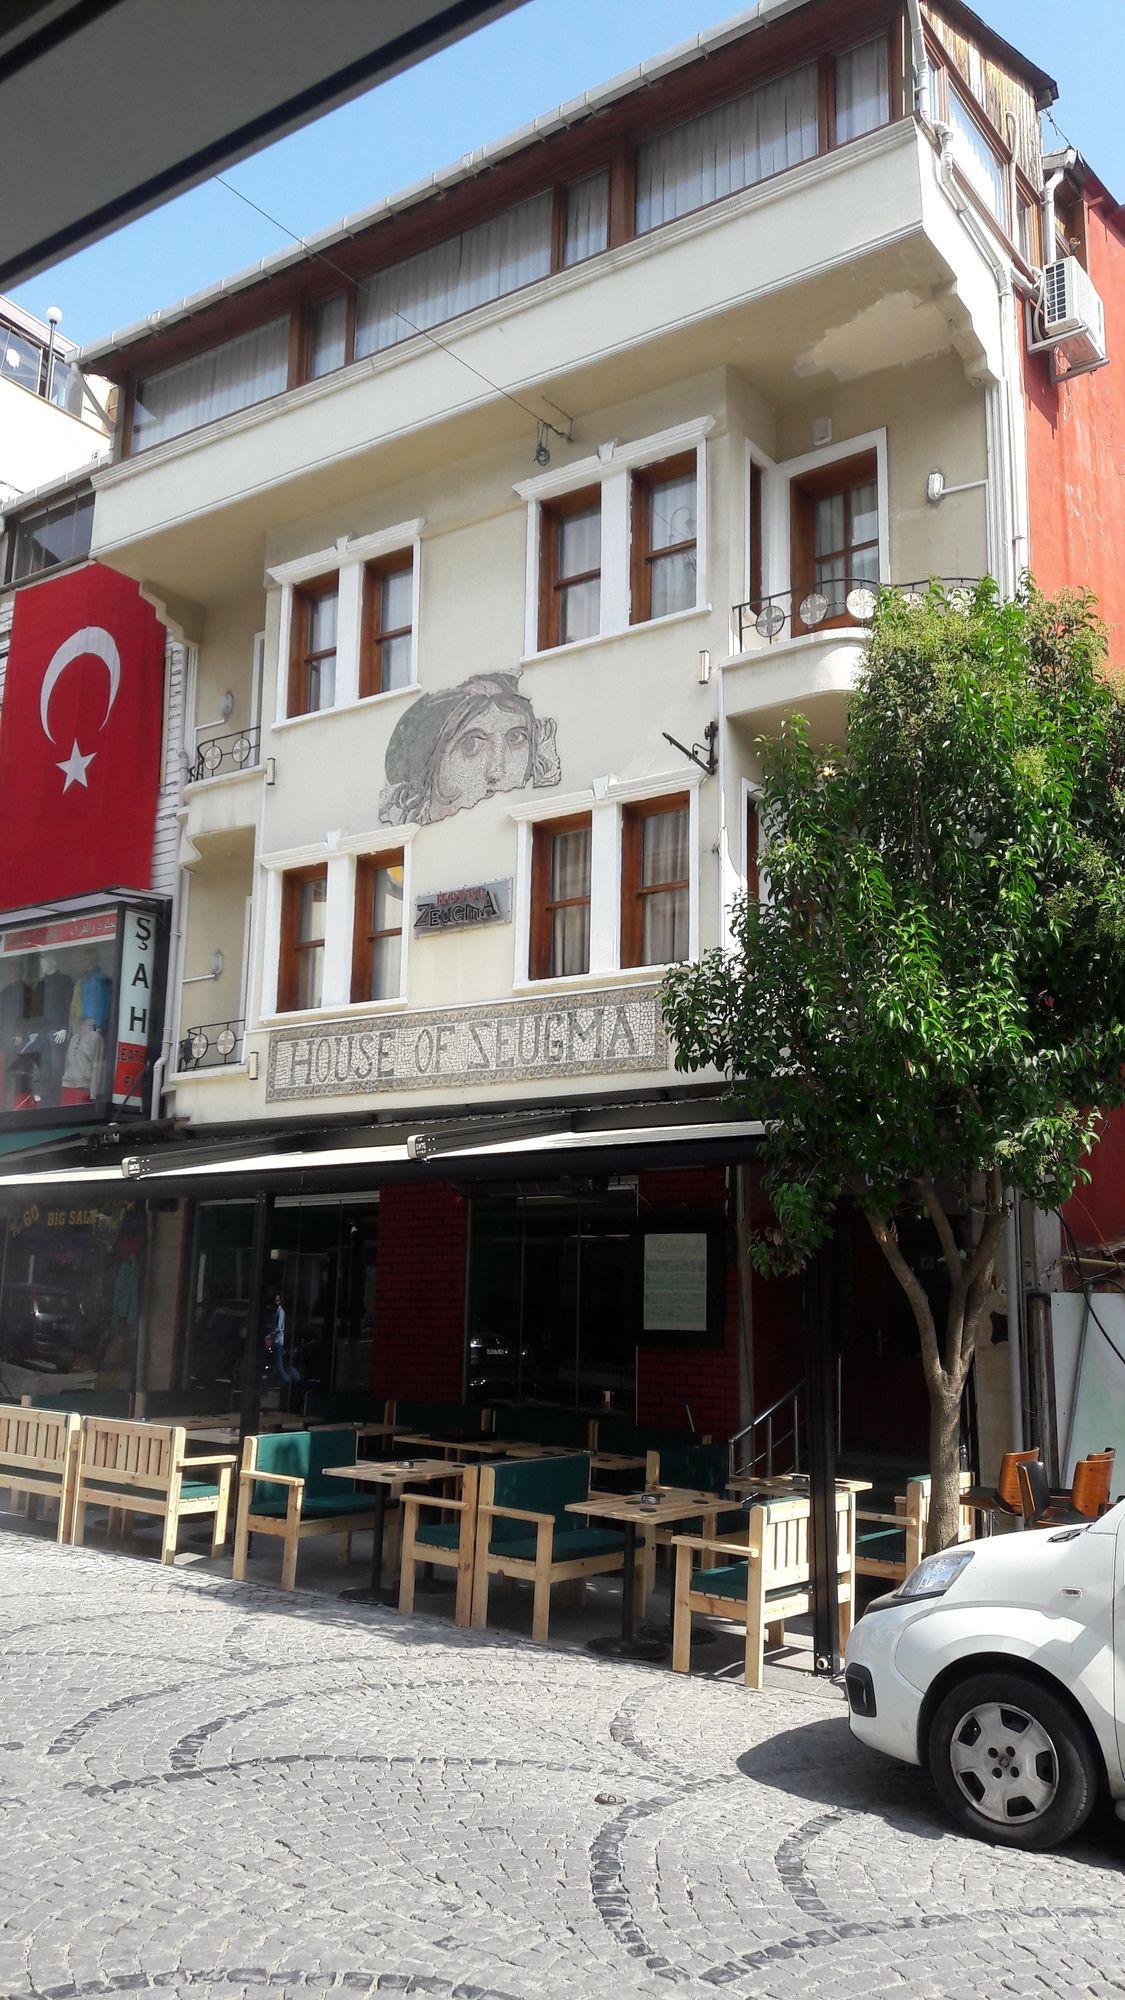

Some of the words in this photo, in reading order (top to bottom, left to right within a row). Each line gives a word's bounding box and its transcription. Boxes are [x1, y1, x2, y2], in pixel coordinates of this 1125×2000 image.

[129, 916, 151, 1034] ŞAH
[288, 1029, 396, 1086] HOUSE
[414, 1025, 456, 1075] OF
[467, 1004, 638, 1069] ZEUGMA
